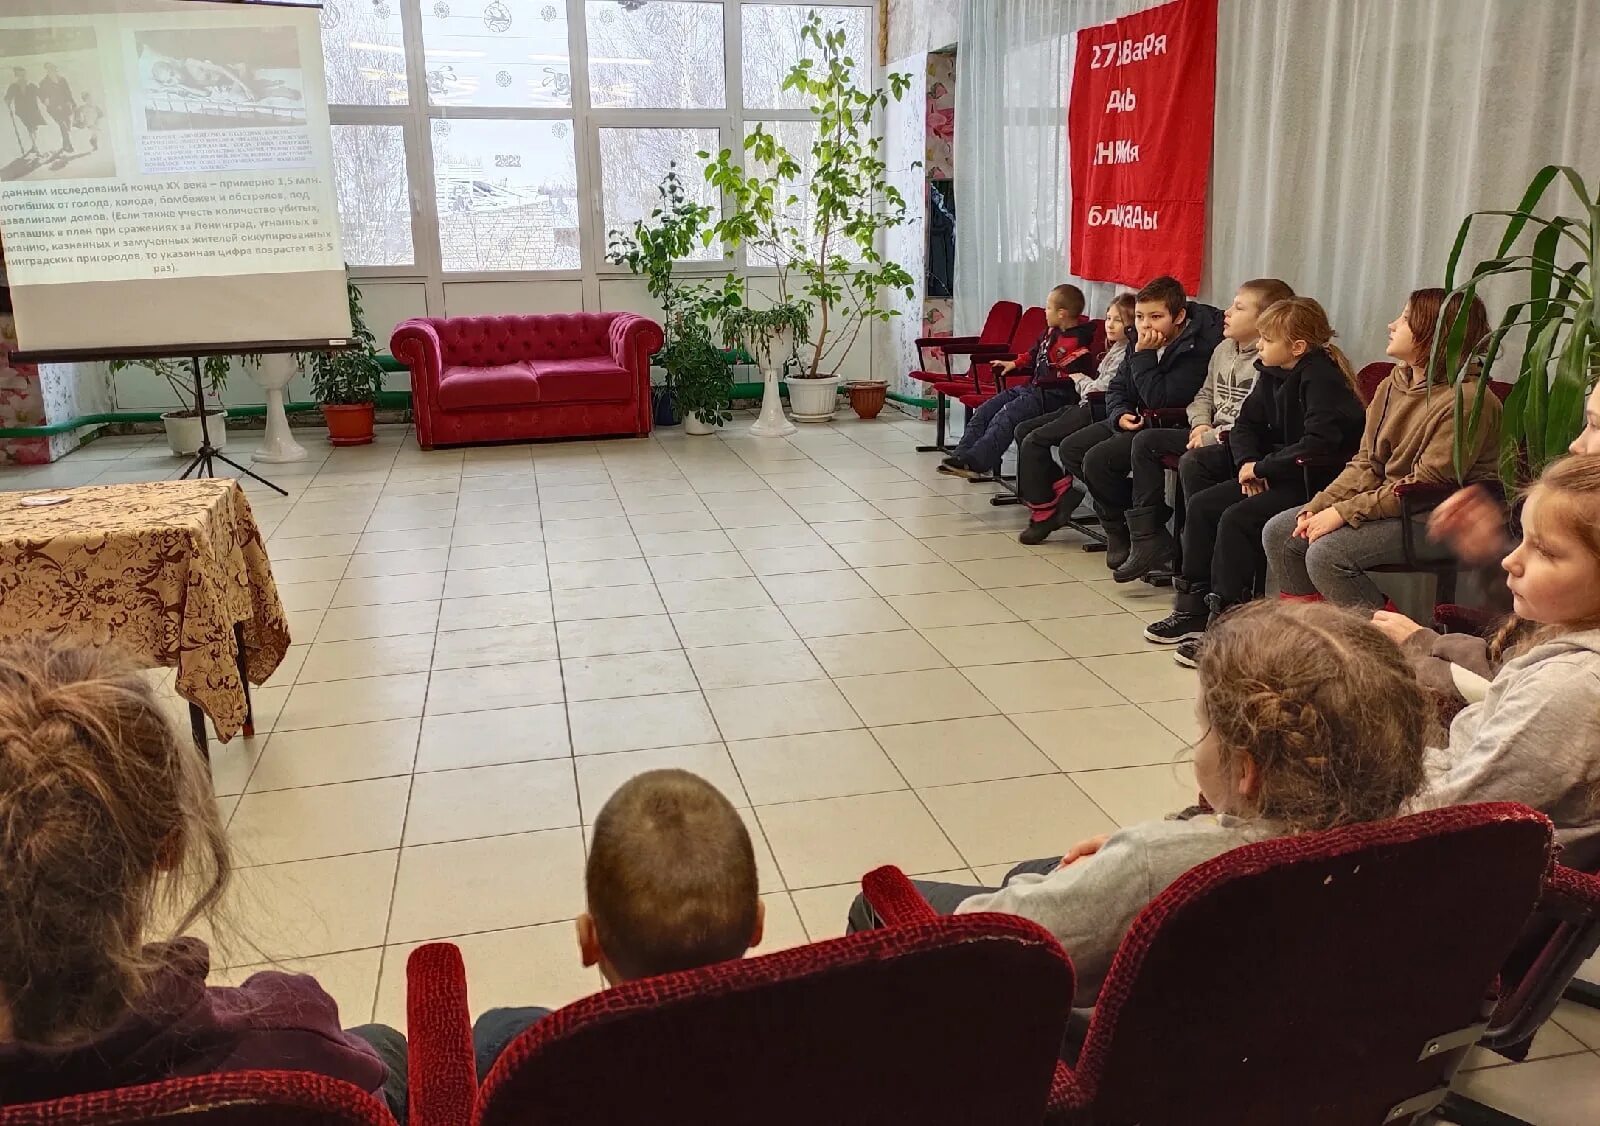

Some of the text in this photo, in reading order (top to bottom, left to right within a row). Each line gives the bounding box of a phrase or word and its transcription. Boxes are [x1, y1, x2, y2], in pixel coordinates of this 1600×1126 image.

[1090, 43, 1118, 70] 27
[2, 188, 48, 199] данным
[50, 182, 129, 195] исследований
[130, 182, 164, 193] конца
[183, 182, 208, 190] века
[219, 178, 275, 189] примерно
[277, 176, 294, 187] 1,5
[0, 201, 56, 212] погибших
[71, 198, 113, 209] голода,
[115, 198, 157, 208] холода,
[228, 192, 287, 202] обстрелов,
[289, 191, 311, 201] под
[70, 213, 109, 223] домов.
[111, 211, 140, 222] (Если
[142, 210, 176, 219] также
[177, 209, 213, 219] учесть
[215, 206, 276, 216] количество
[278, 203, 320, 215] убитых,
[66, 228, 93, 236] плен
[95, 227, 117, 236] при
[118, 224, 178, 235] сражениях
[194, 221, 257, 230] Ленинград,
[259, 218, 309, 228] угнанных
[4, 244, 50, 253] манию,
[51, 240, 112, 251] казненных
[122, 237, 190, 248] замученных
[191, 233, 238, 244] жителей
[240, 231, 332, 243] оккупированных
[76, 252, 144, 264] пригородов,
[145, 251, 158, 259] то
[159, 249, 216, 260] указанная
[217, 247, 253, 257] цифра
[255, 245, 307, 255] возрастет
[317, 242, 334, 252] 35
